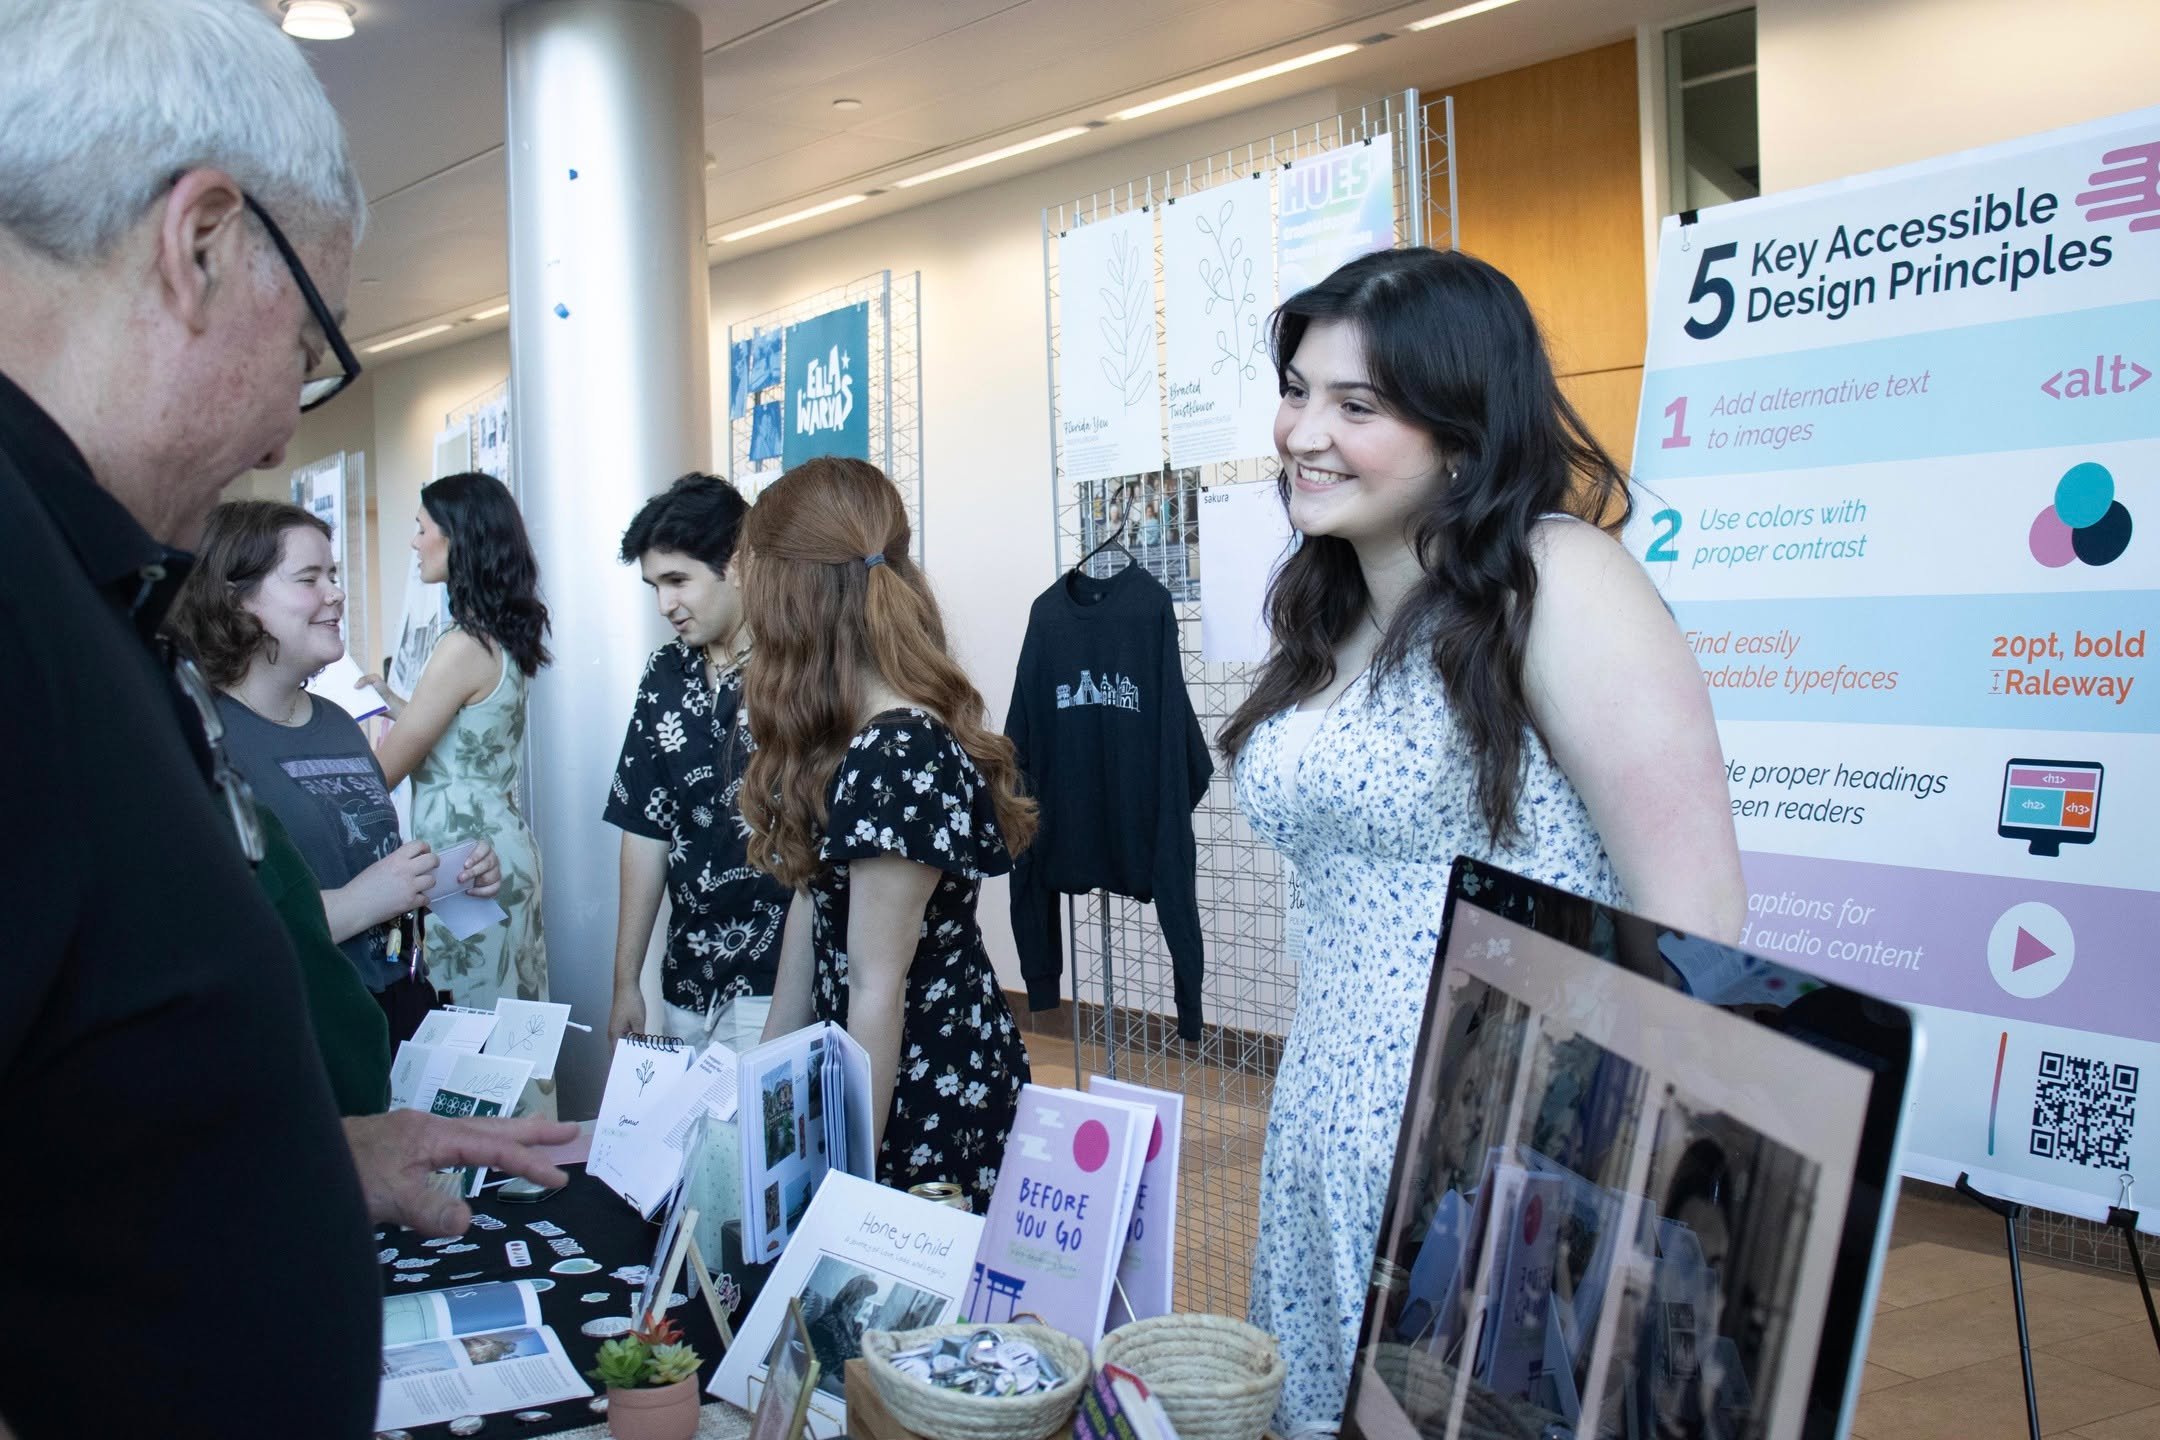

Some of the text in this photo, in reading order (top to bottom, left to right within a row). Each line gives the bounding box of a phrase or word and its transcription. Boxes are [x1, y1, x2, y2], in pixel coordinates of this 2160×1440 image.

[1282, 155, 1371, 214] HUES
[1683, 186, 2058, 340] 5 Key Accessible
[1747, 232, 2113, 323] Design Principles
[807, 344, 841, 399] ELLA
[2040, 355, 2152, 400] <alt>
[1661, 370, 1930, 449] 1 Add alternative text
[1707, 421, 1814, 452] to images
[1204, 492, 1229, 504] sakura
[1645, 499, 1867, 562] 2 Use colors with
[1692, 534, 1867, 569] proper contrast
[1685, 630, 1800, 659] Find easily
[1991, 629, 2146, 661] 20pt, bold
[1702, 664, 1898, 694] adable typefaces
[2004, 669, 2134, 704] Raleway
[1749, 765, 1831, 790] proper
[1833, 763, 1949, 800] headings
[1775, 798, 1865, 825] readers
[1748, 891, 1876, 928] aptions for
[1756, 928, 1822, 955] audio
[1826, 936, 1924, 971] content
[1019, 1177, 1090, 1220] BEFORE
[860, 1210, 955, 1256] Honey Child
[1015, 1210, 1082, 1252] YOU GO
